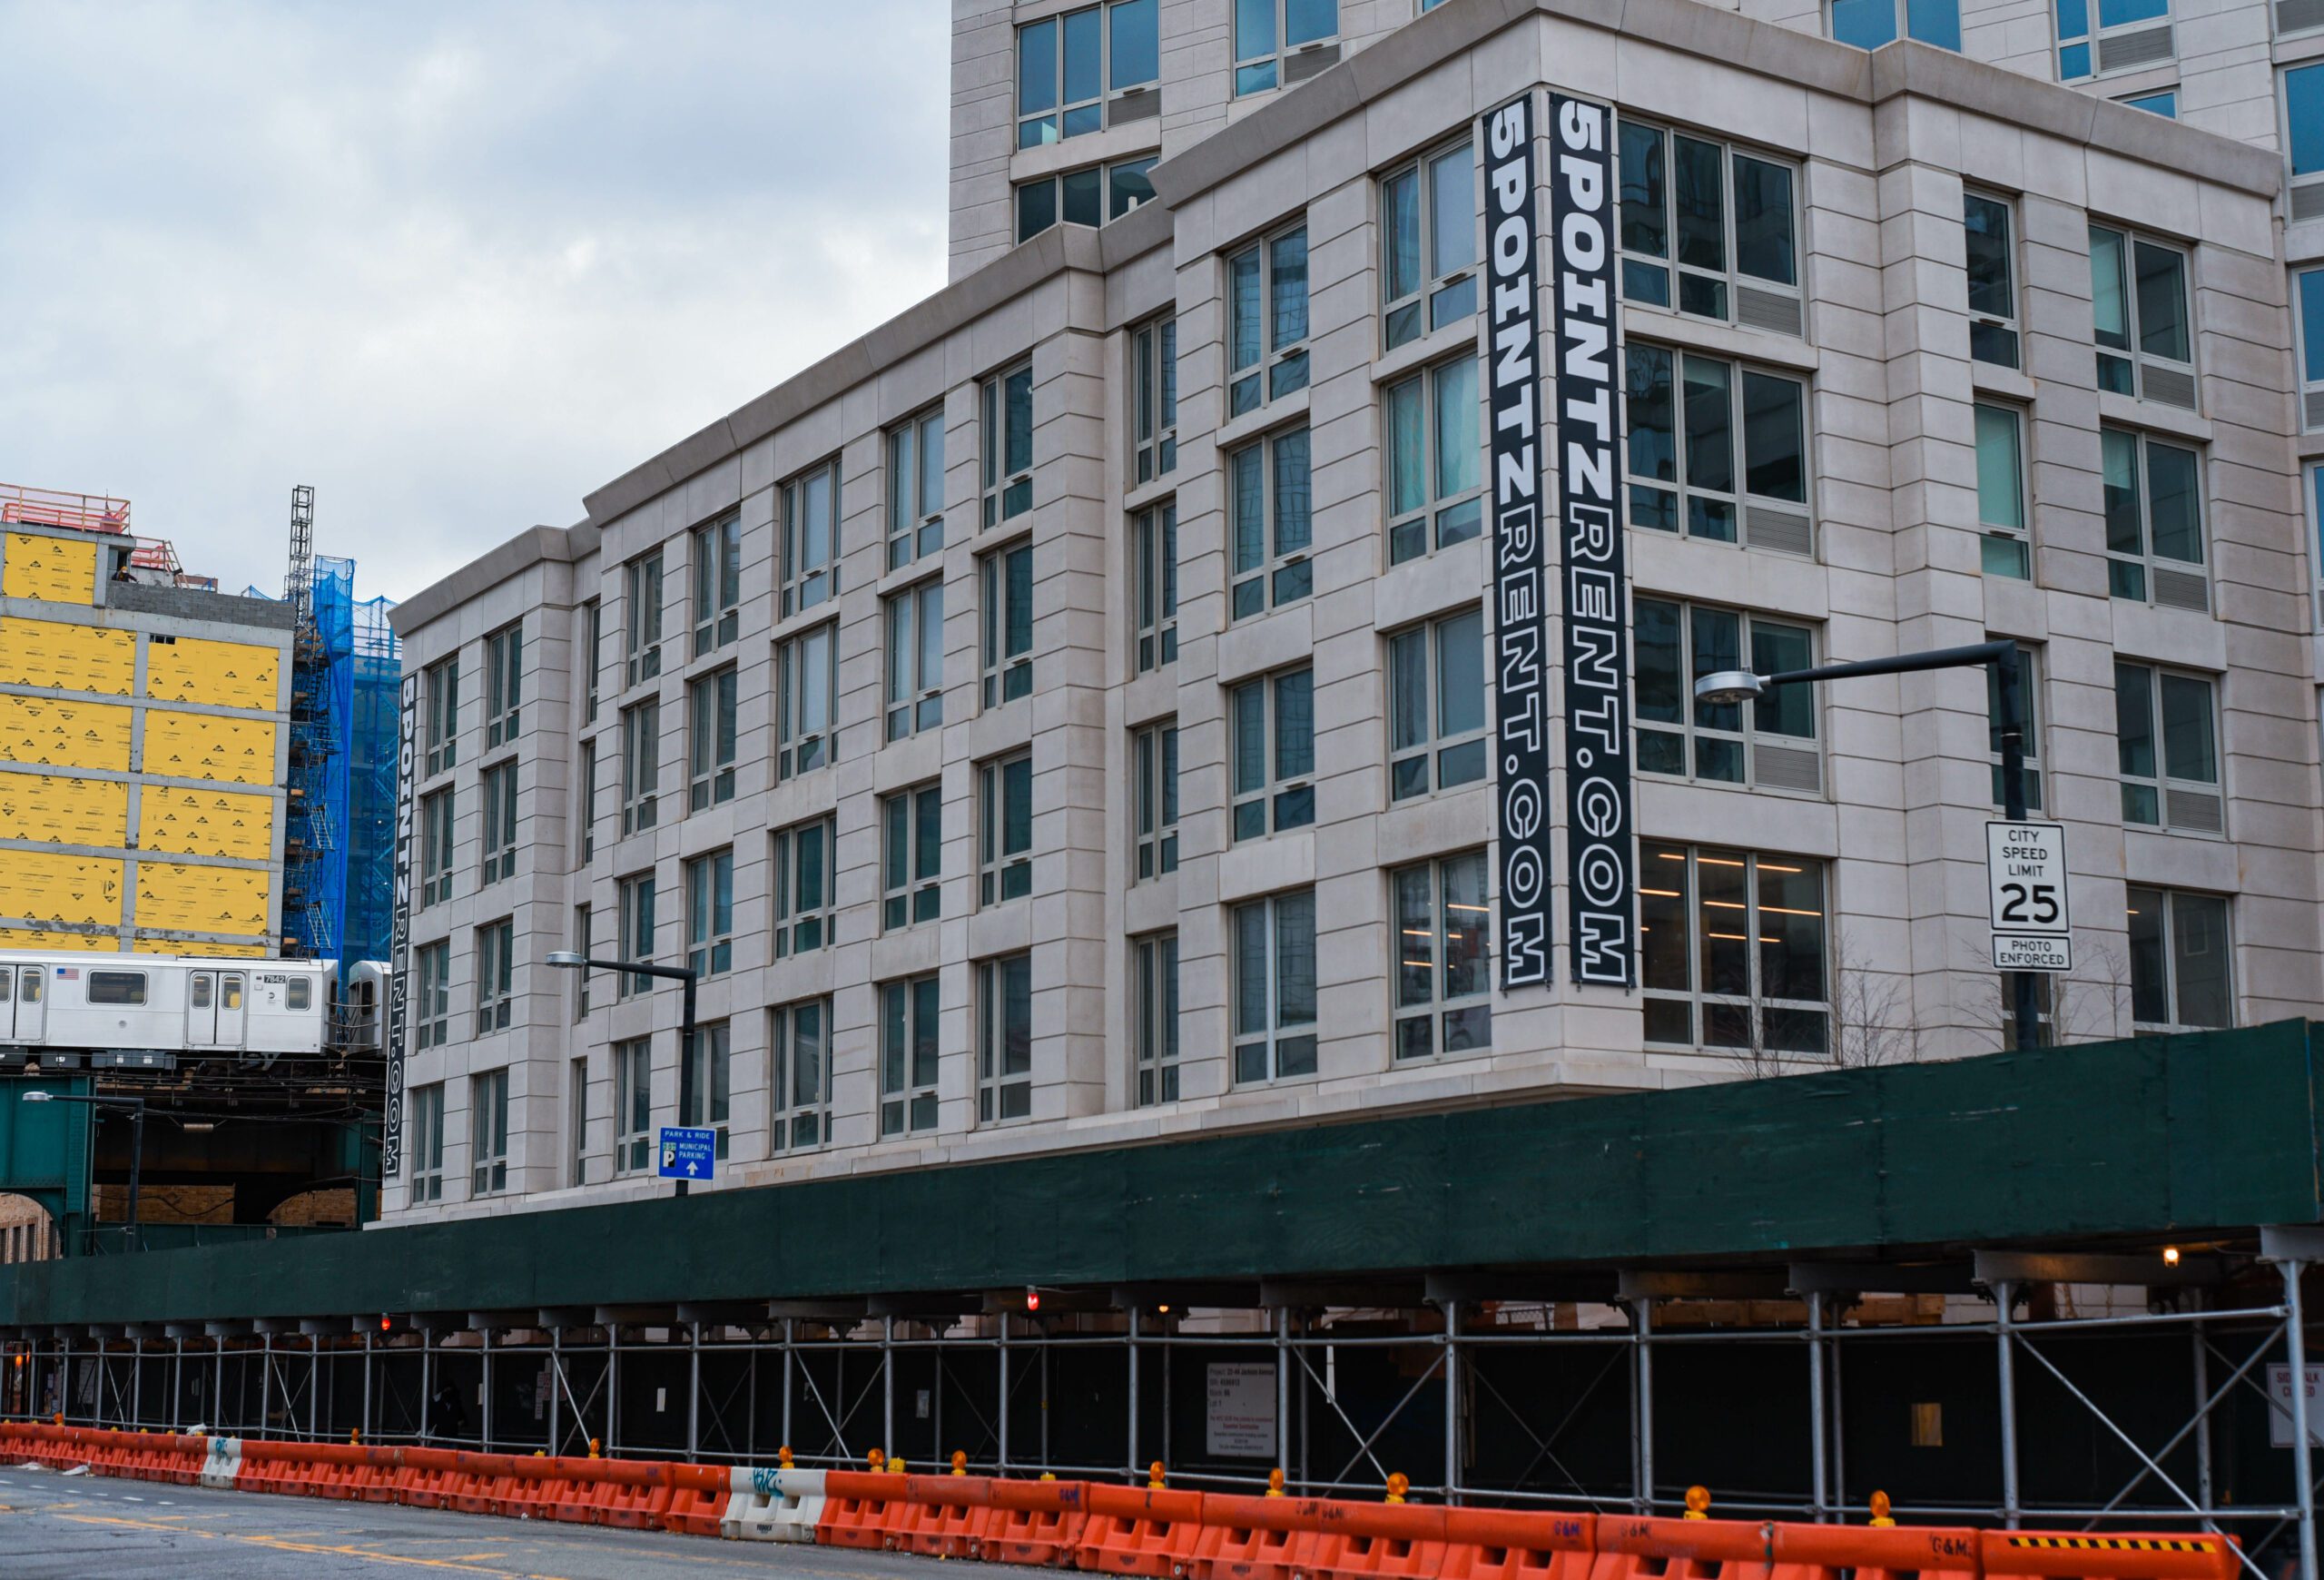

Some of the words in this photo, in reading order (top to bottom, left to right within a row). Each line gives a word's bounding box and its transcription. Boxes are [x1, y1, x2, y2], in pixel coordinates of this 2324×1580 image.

[2008, 830, 2040, 843] CITY
[2003, 846, 2048, 860] SPEED
[2008, 864, 2044, 877] LIMIT
[2000, 883, 2059, 923] 25
[2011, 940, 2052, 952] PHOTO
[2000, 953, 2064, 965] ENFORCED
[266, 975, 285, 983] 7842
[665, 1131, 684, 1139] PARK
[679, 1142, 712, 1151] MUNICIPAL
[663, 1150, 675, 1168] P
[678, 1150, 705, 1160] PARKING
